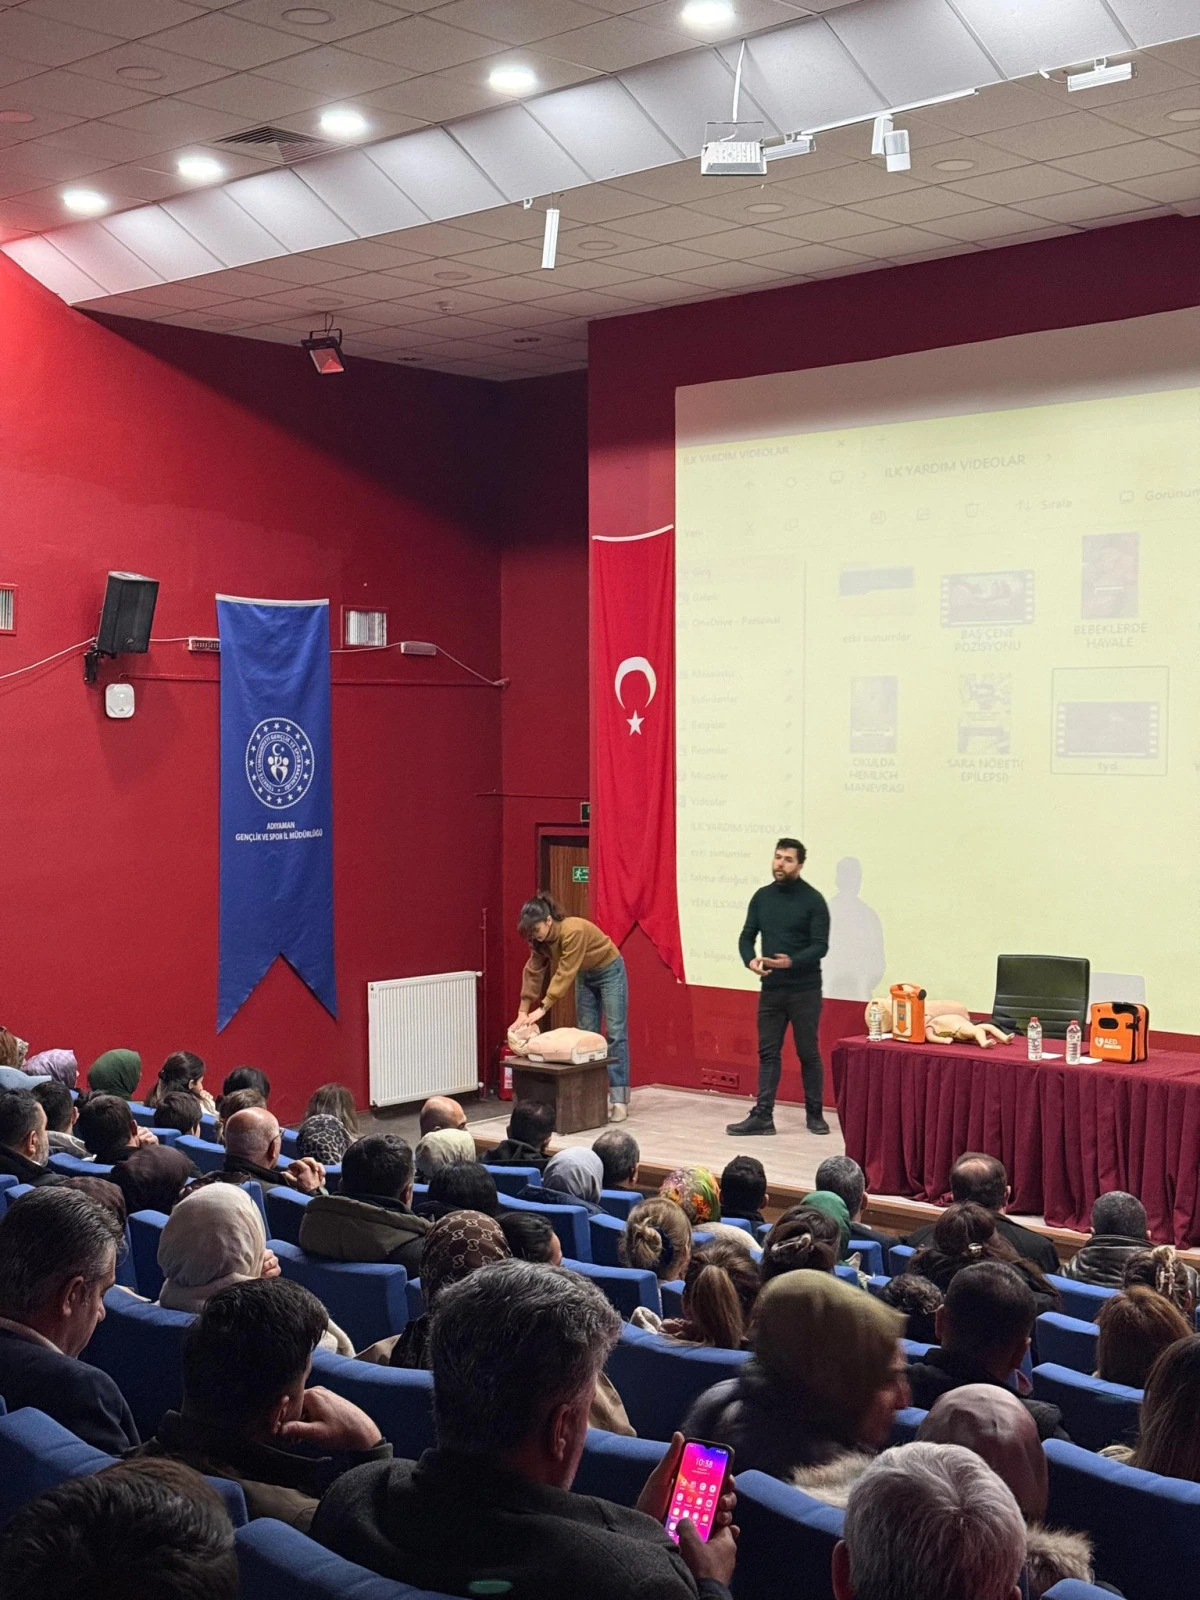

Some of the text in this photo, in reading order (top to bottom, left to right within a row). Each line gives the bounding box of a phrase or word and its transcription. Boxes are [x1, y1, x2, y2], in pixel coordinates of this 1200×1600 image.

[905, 461, 957, 475] YARDIM
[1073, 622, 1148, 635] BEBEKLERDE
[1086, 637, 1135, 649] HAVALE
[266, 821, 296, 830] ADIYAMAN
[235, 828, 324, 842] GENÇLİK VE SPOR İL MÜDÜRLÜĞÜ
[1104, 1037, 1119, 1045] AED
[695, 1458, 713, 1468] 10:38
